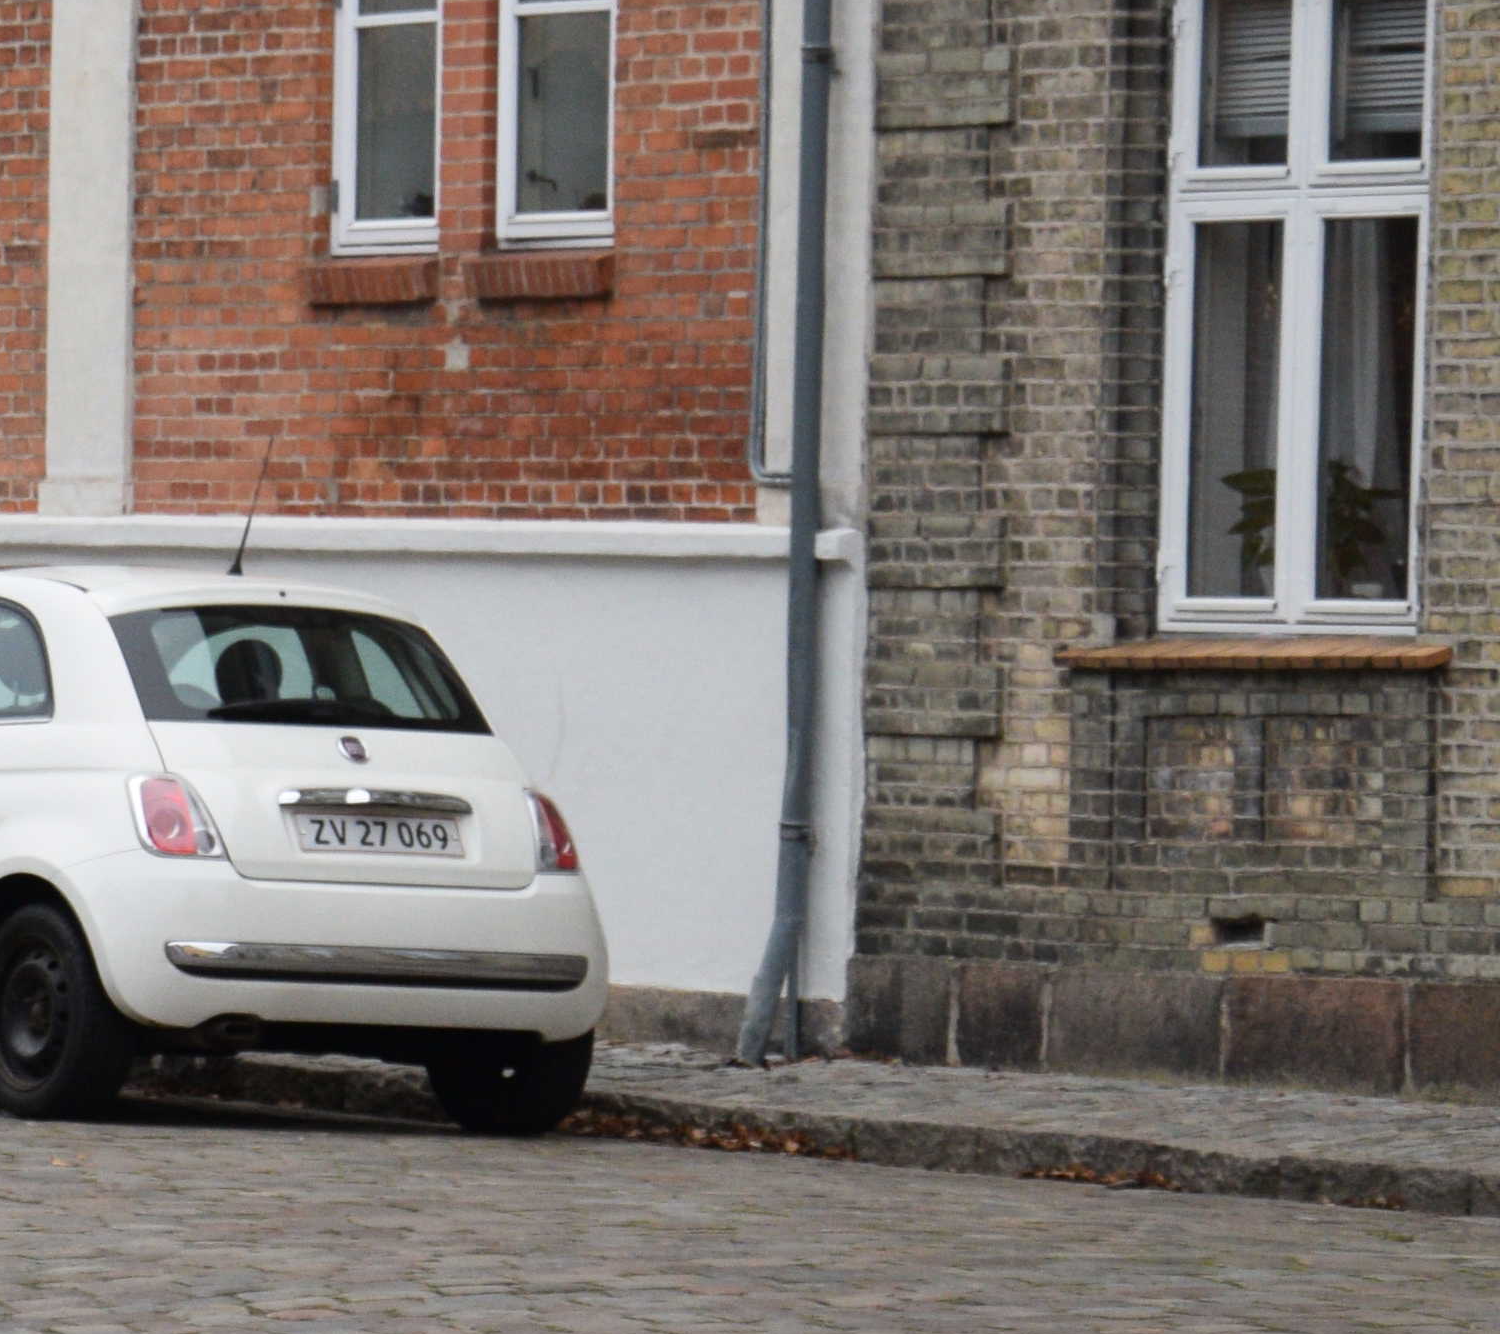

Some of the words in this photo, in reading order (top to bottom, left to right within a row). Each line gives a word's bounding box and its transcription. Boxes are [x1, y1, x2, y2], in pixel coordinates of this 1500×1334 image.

[309, 819, 347, 846] ZV
[355, 819, 392, 847] 27
[396, 821, 449, 850] 069
